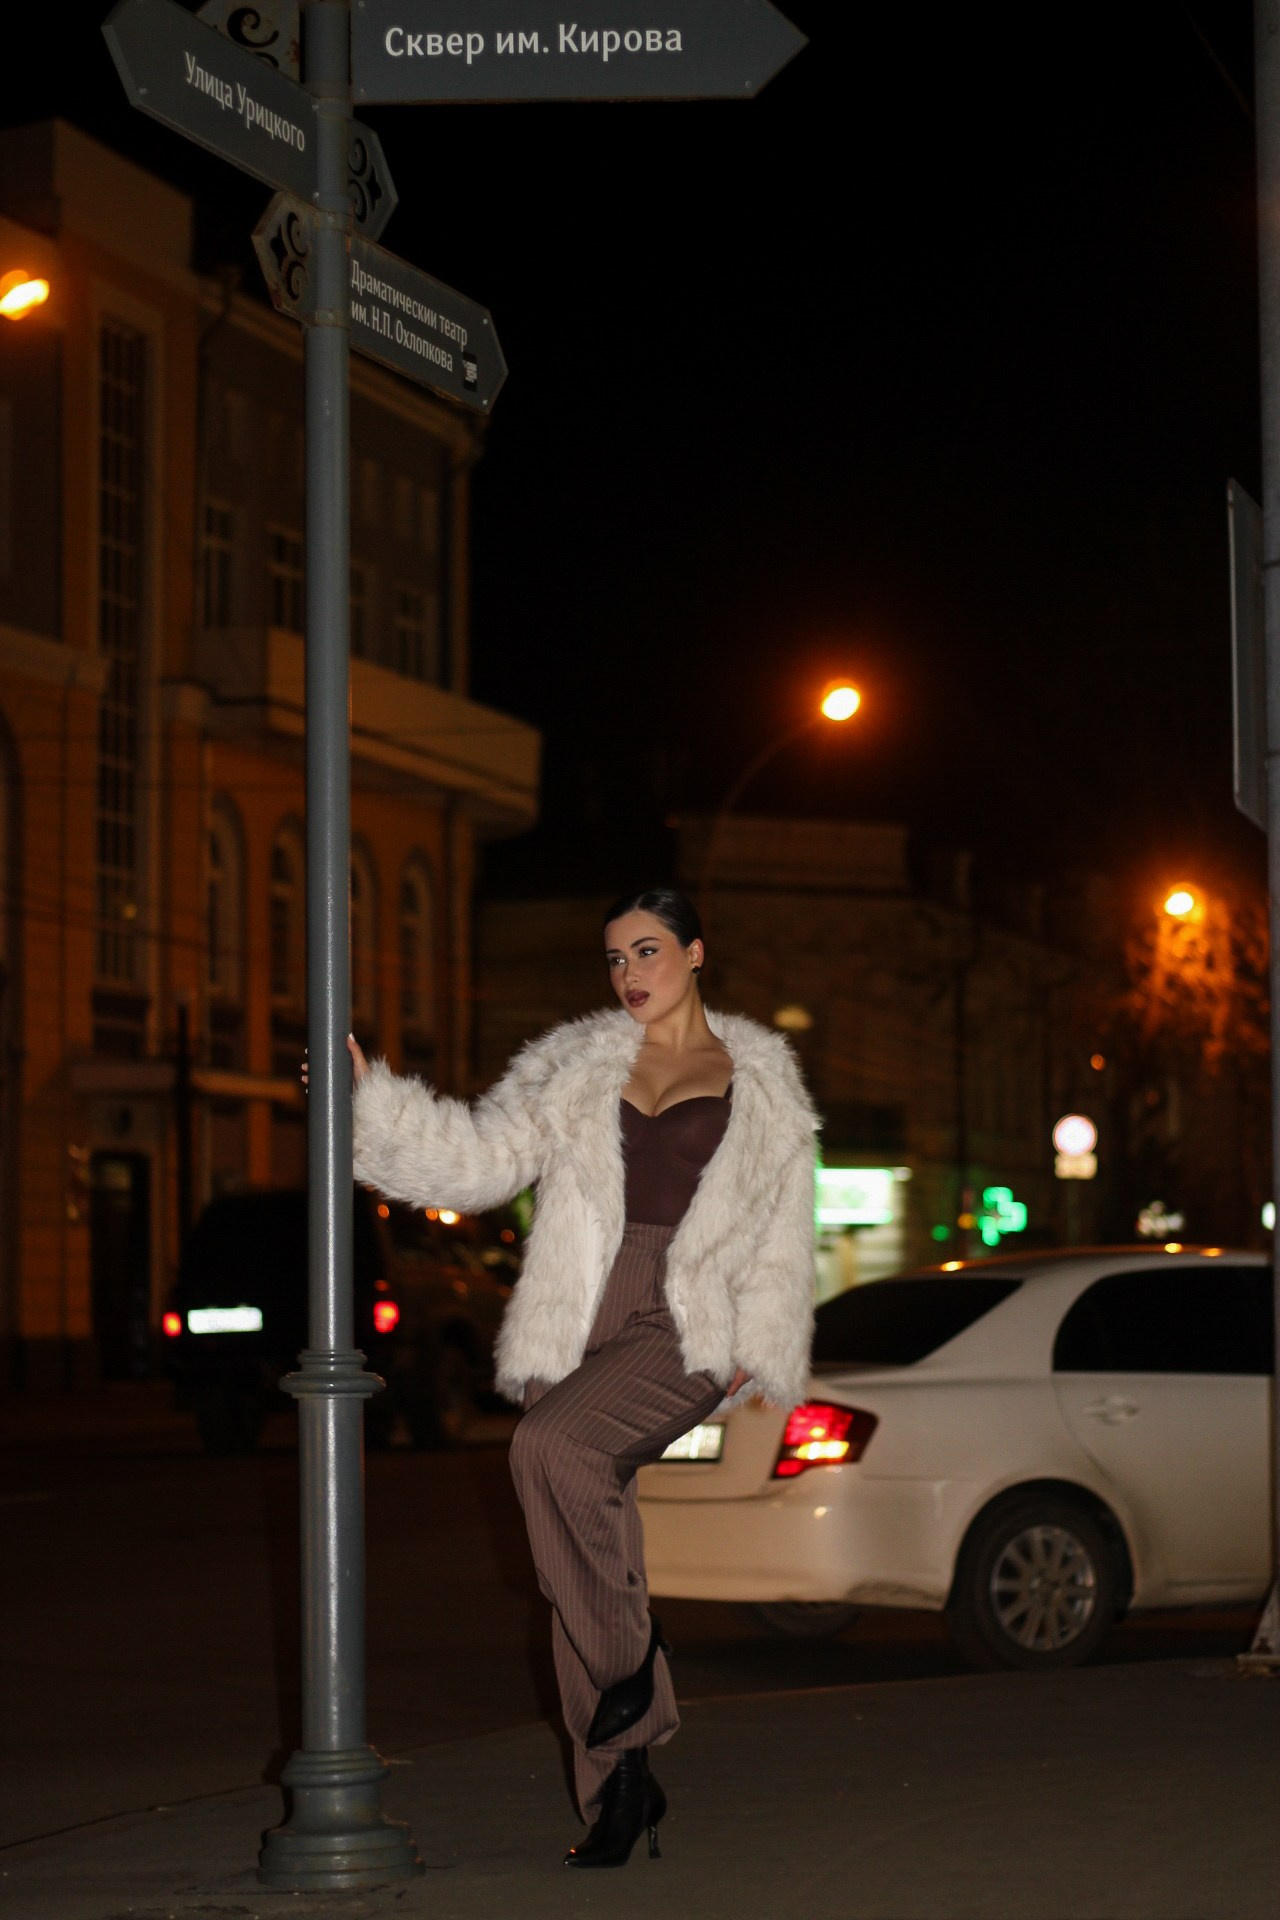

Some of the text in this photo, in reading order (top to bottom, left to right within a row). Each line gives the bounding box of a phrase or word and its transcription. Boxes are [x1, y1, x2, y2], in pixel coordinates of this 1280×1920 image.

[385, 24, 683, 64] Сквер им. Кирова
[184, 51, 305, 152] Улица Урицкого
[351, 301, 370, 326] им.
[372, 306, 394, 340] Н.П.
[395, 320, 453, 372] Охлопкова
[439, 314, 468, 352] театр
